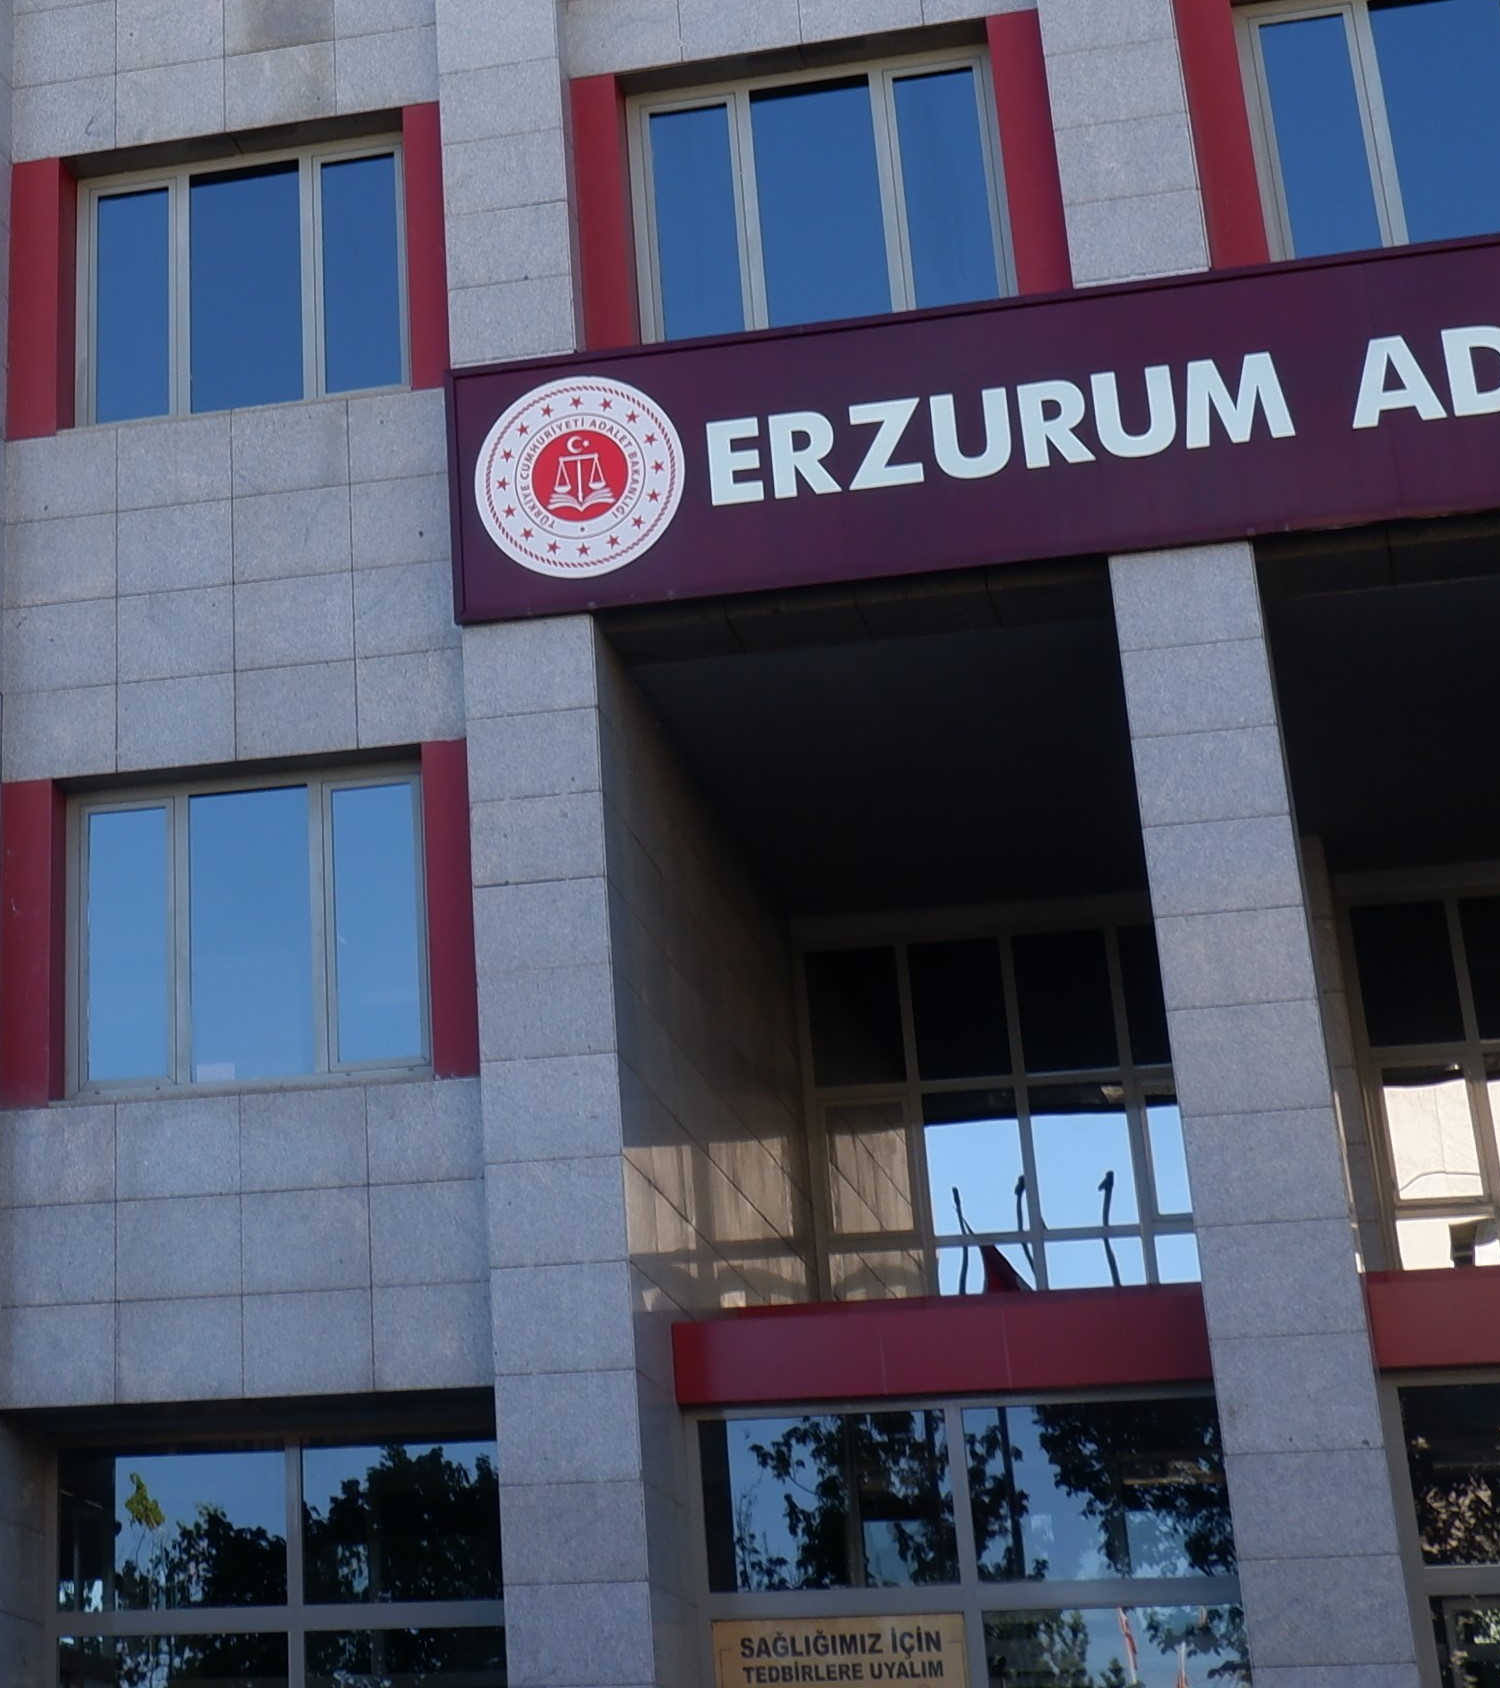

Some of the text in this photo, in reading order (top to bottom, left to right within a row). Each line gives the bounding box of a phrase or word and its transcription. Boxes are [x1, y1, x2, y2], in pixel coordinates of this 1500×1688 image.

[706, 351, 1297, 507] ERZURUM
[519, 416, 641, 530] TÜRKİYE CUMHURİYETİ ADALET BAKANLIĞI
[740, 1625, 942, 1659] SAĞLIĞIMIZ İÇİN
[742, 1660, 944, 1684] TEDBİRLERE UYALIM
